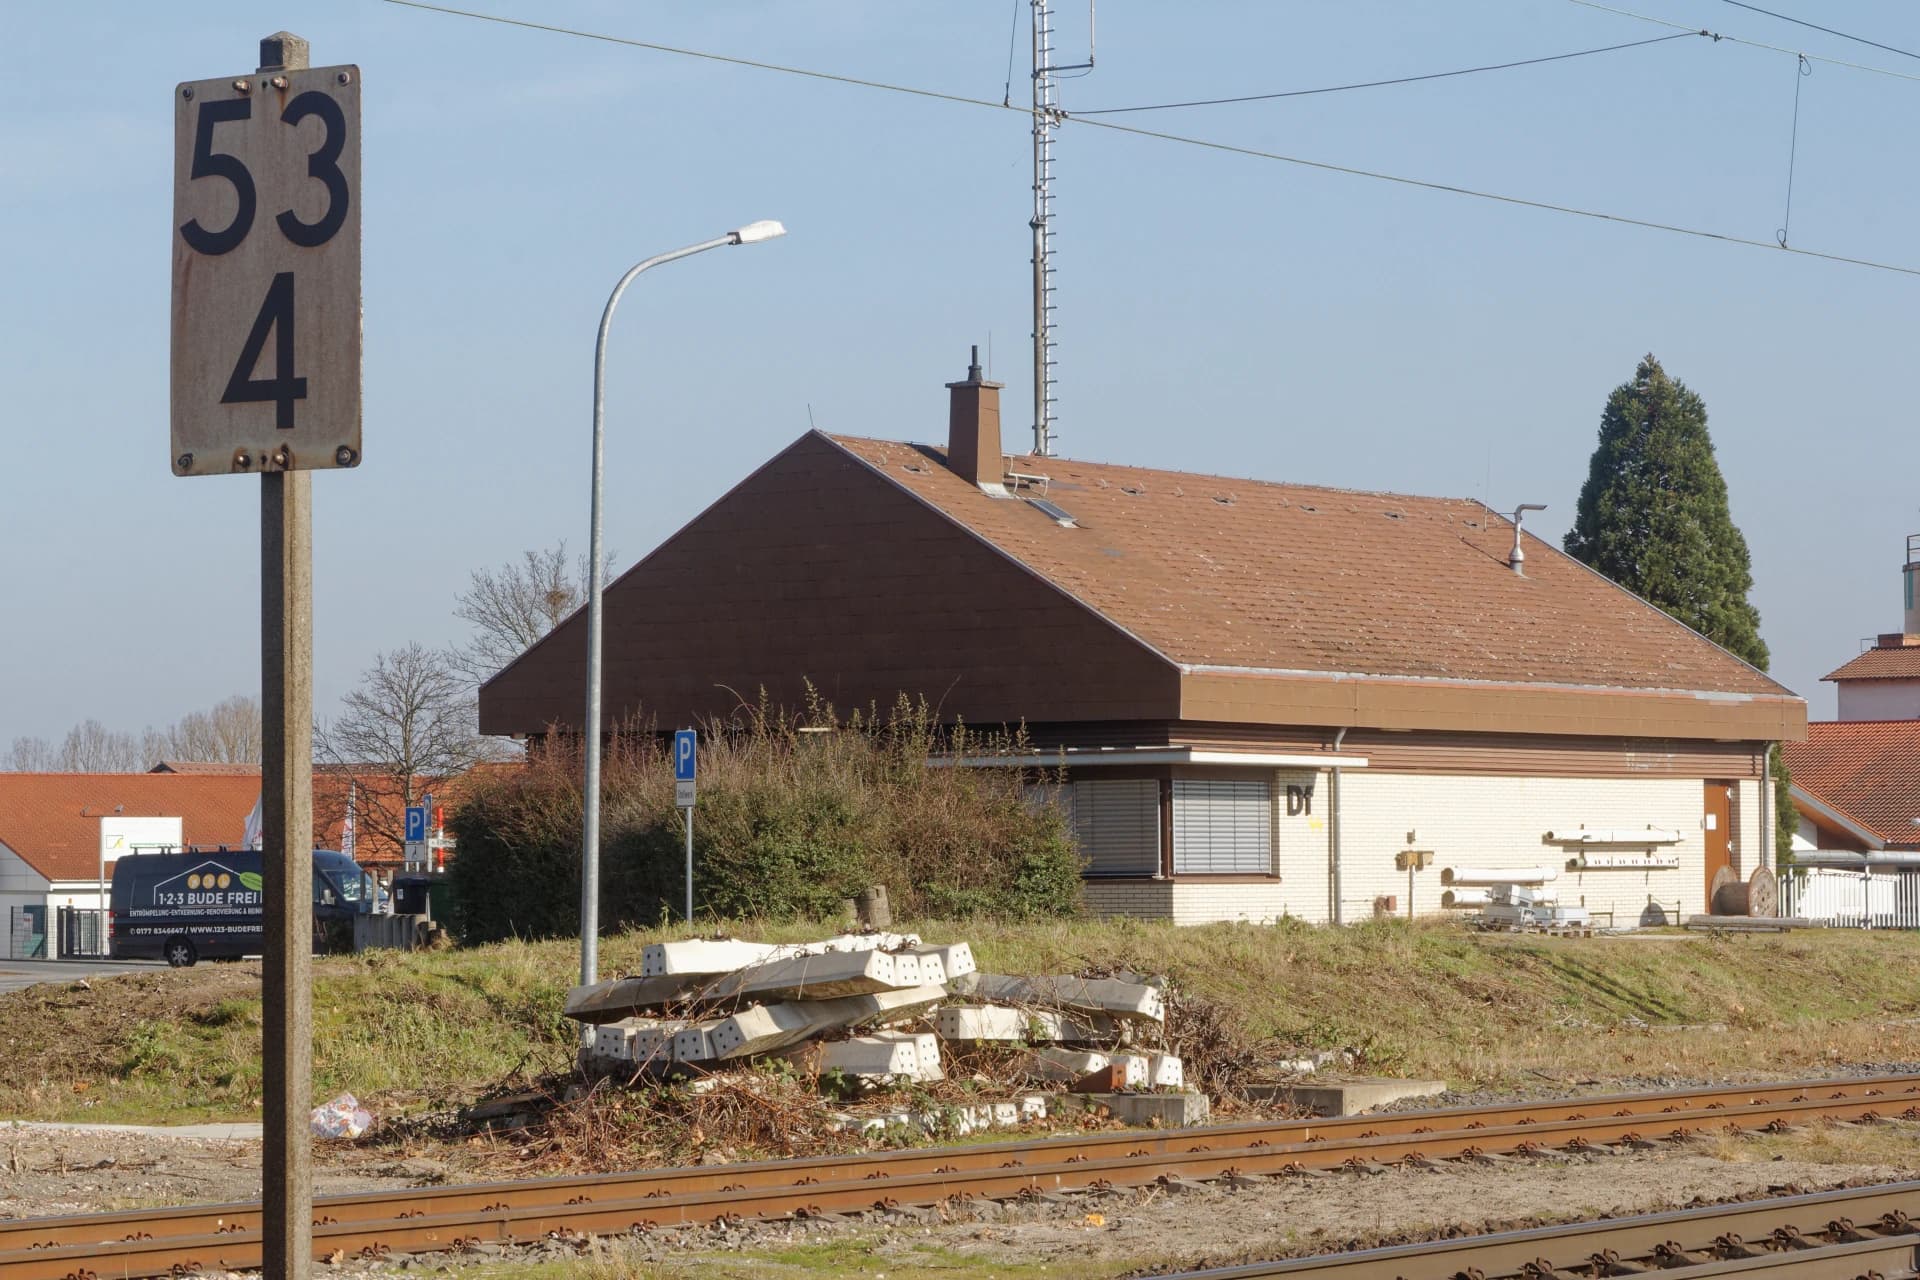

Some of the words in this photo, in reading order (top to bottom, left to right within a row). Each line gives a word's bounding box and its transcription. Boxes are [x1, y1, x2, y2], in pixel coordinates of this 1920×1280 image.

[180, 90, 350, 256] 53
[220, 271, 308, 430] 4
[680, 737, 691, 774] P
[409, 811, 421, 838] P
[187, 892, 223, 905] BUDE
[227, 892, 257, 904] FREI
[136, 927, 152, 935] 0177
